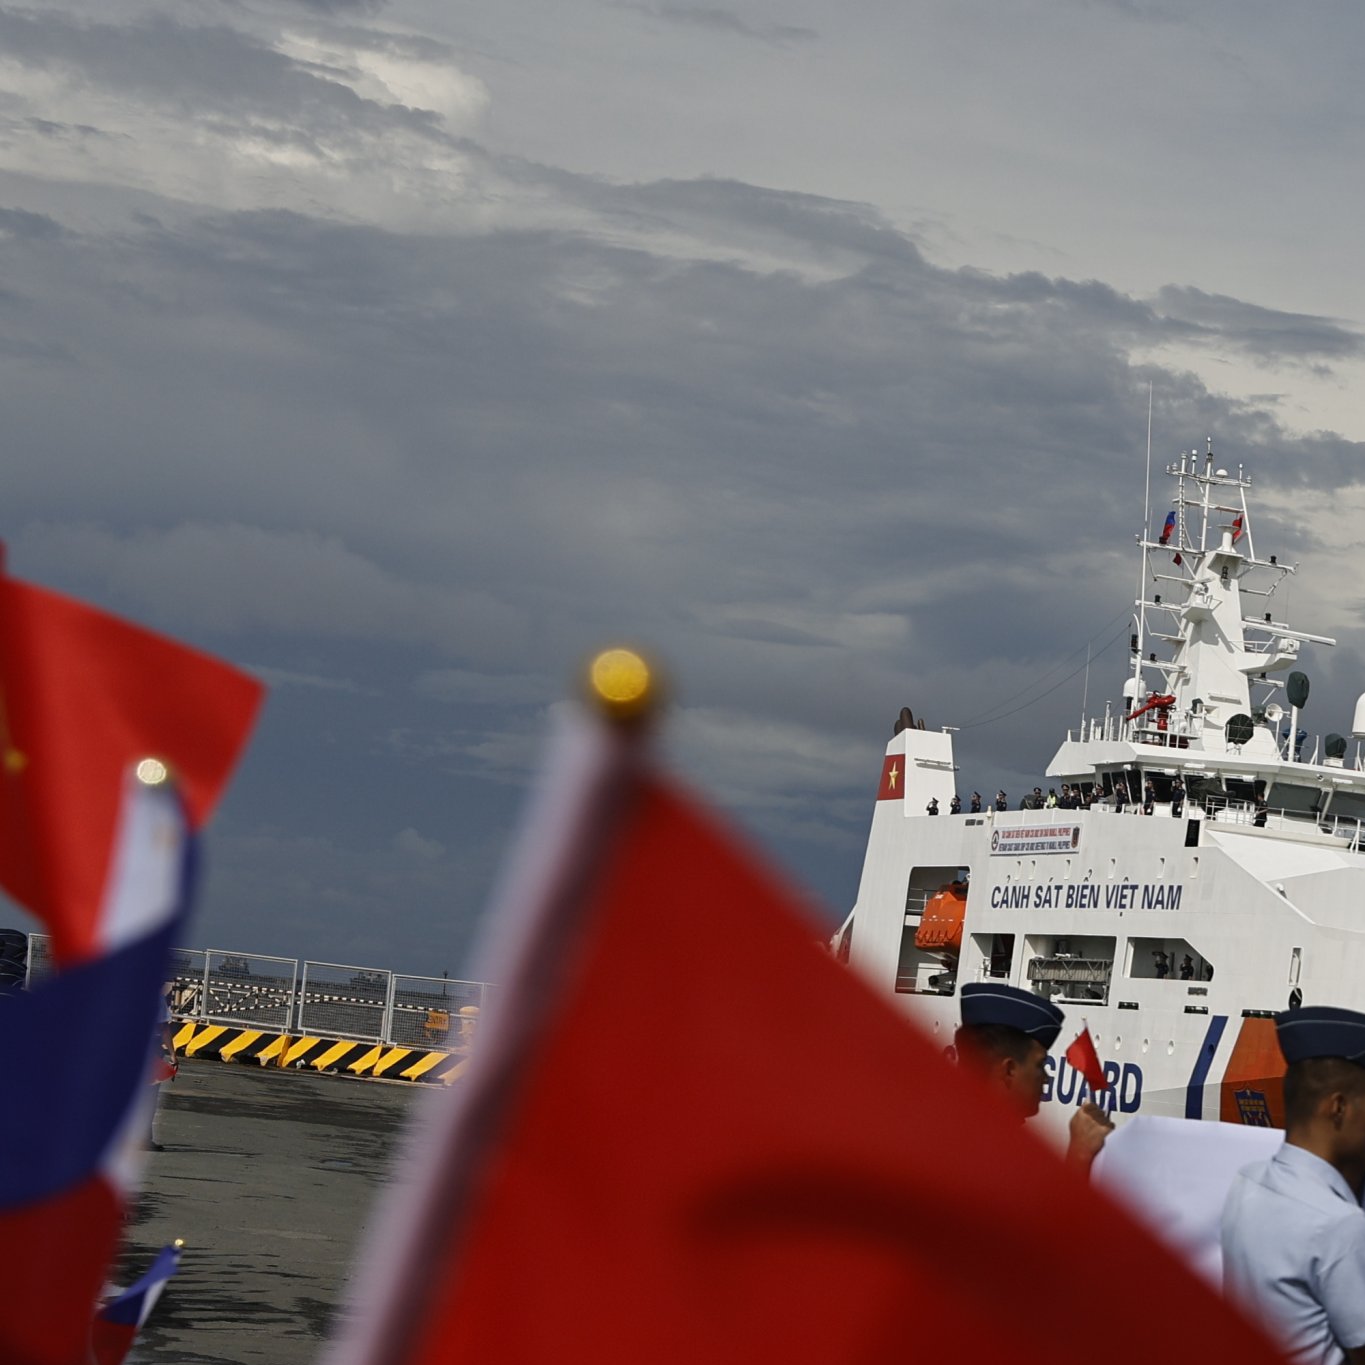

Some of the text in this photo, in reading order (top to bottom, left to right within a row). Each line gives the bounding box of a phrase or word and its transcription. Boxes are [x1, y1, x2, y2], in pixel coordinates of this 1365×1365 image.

[991, 869, 1182, 917] CẢNH SÁT BIỂN VIỆT NAM
